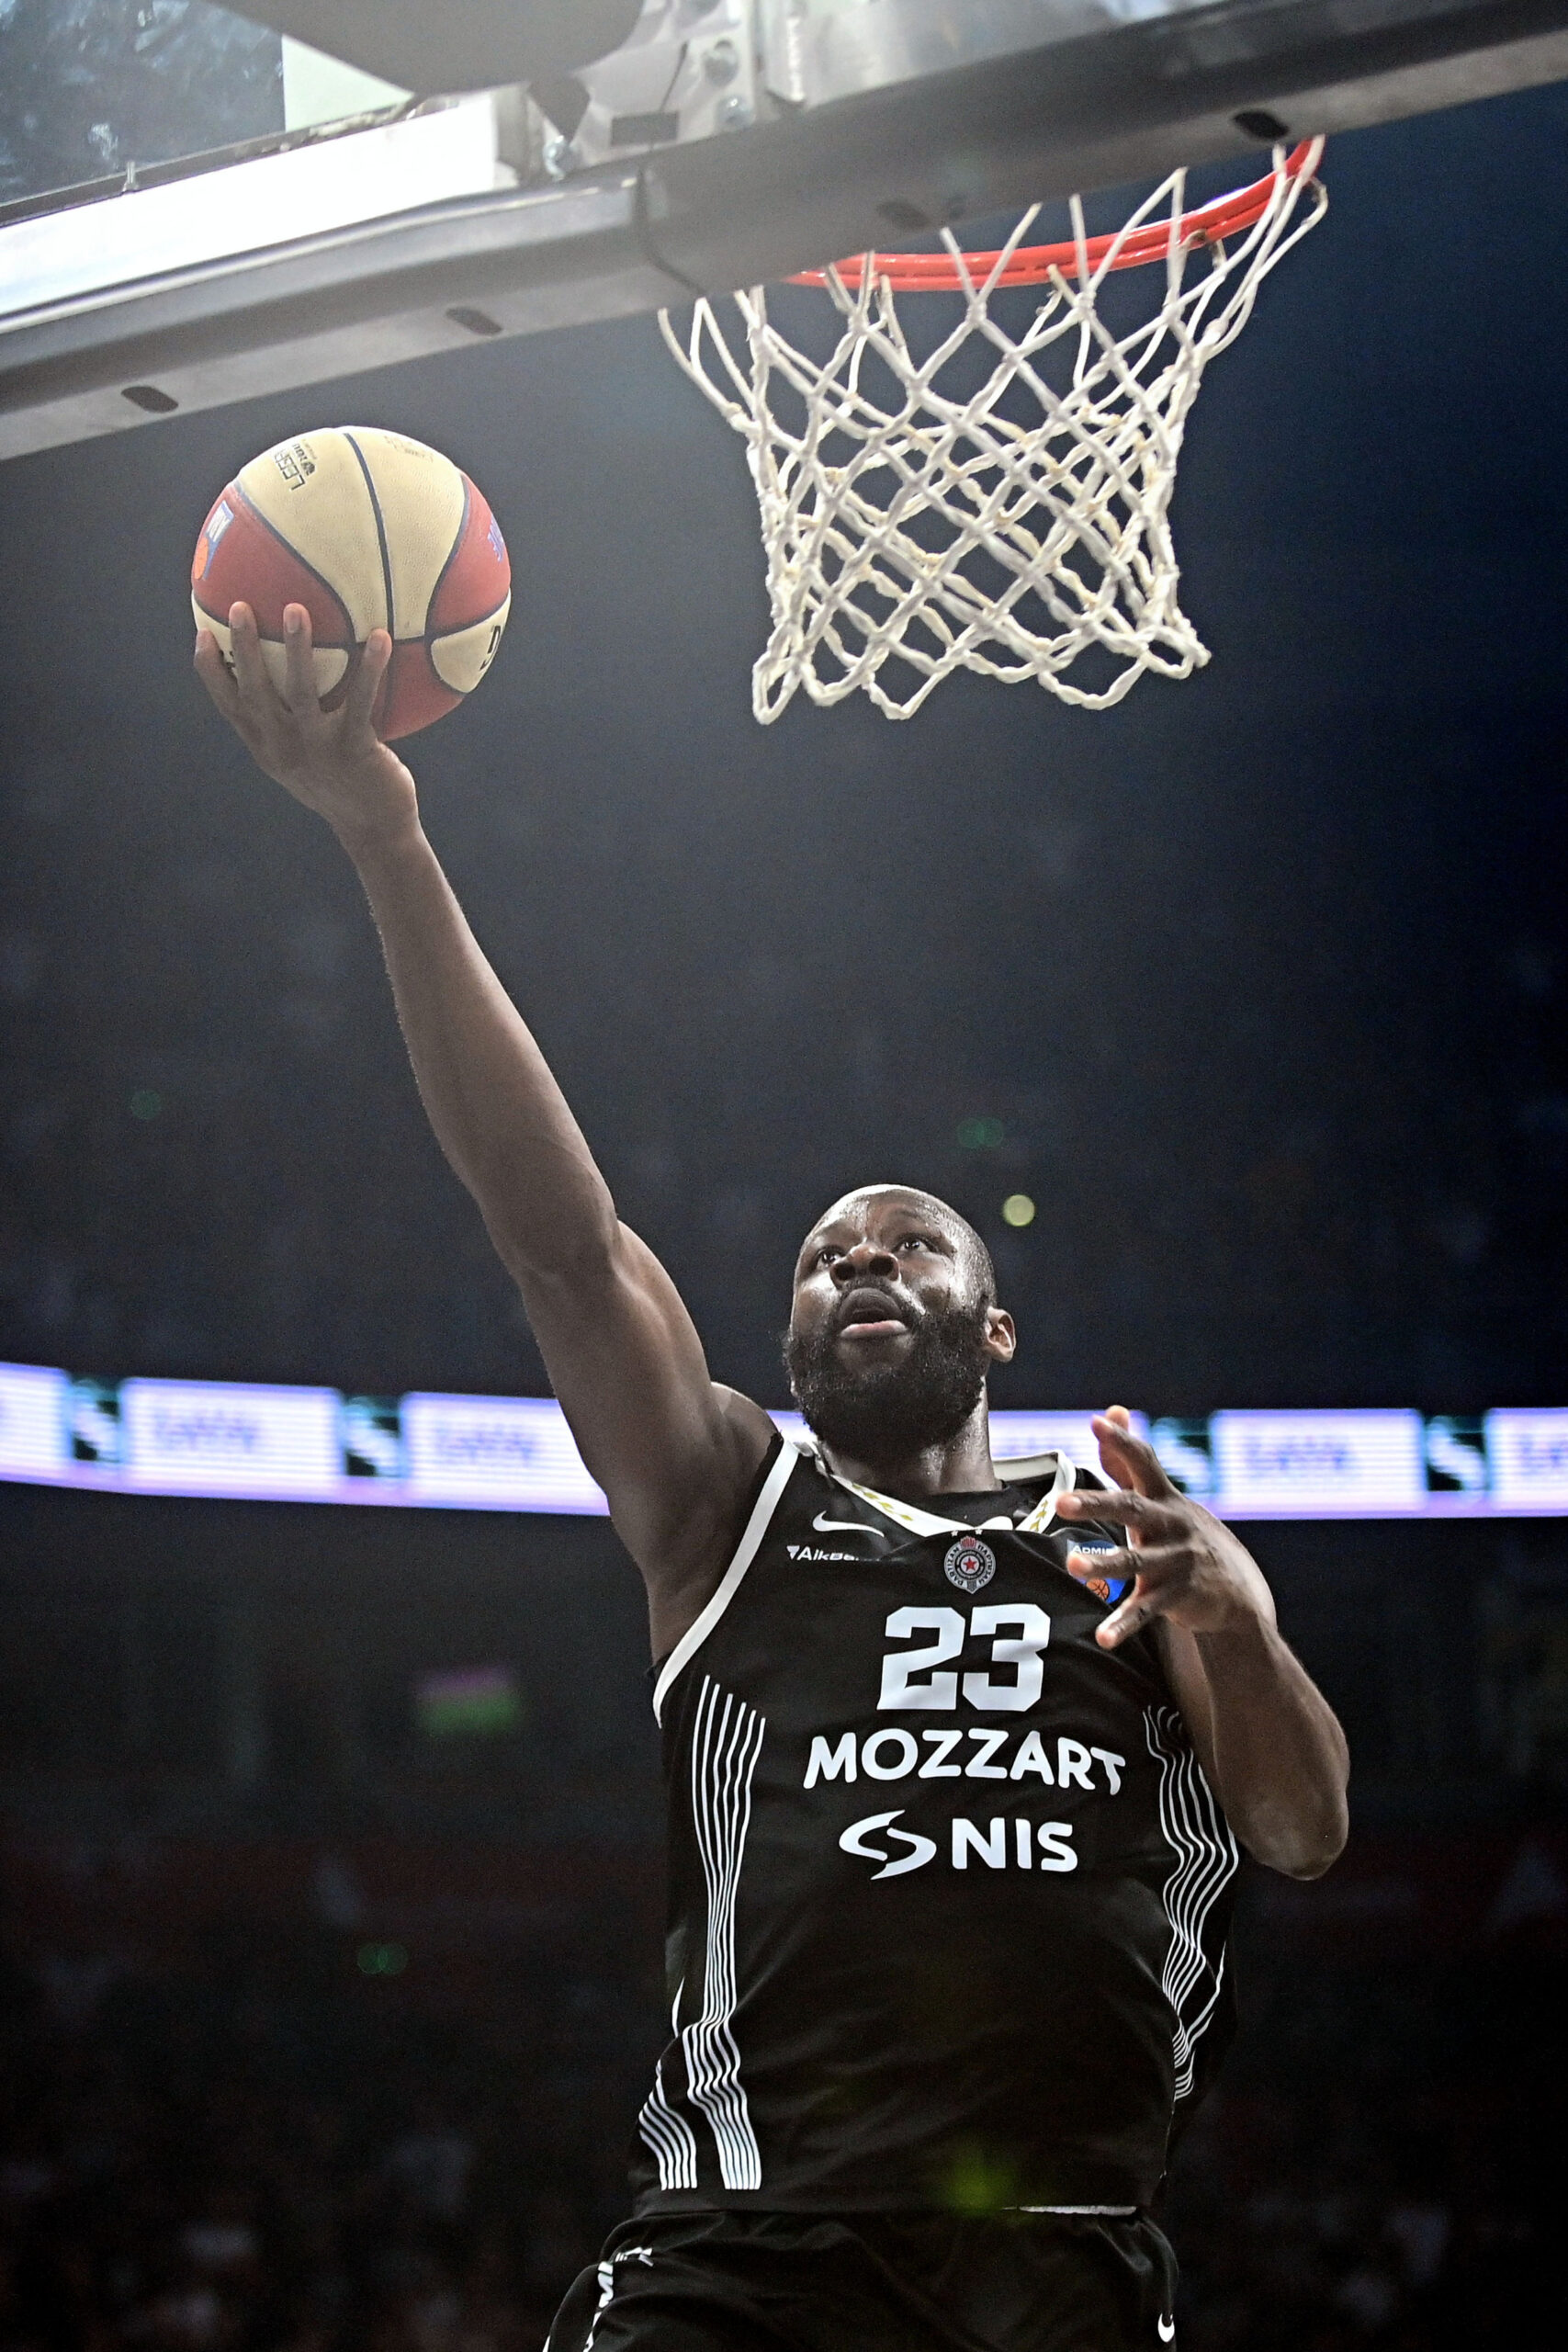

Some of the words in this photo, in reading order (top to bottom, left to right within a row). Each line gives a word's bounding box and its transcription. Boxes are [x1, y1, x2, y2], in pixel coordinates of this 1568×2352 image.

[1071, 1544, 1111, 1555] ADMI
[876, 1603, 1051, 1712] 23
[803, 1728, 1126, 1795] MOZZART
[952, 1816, 1078, 1872] NIS
